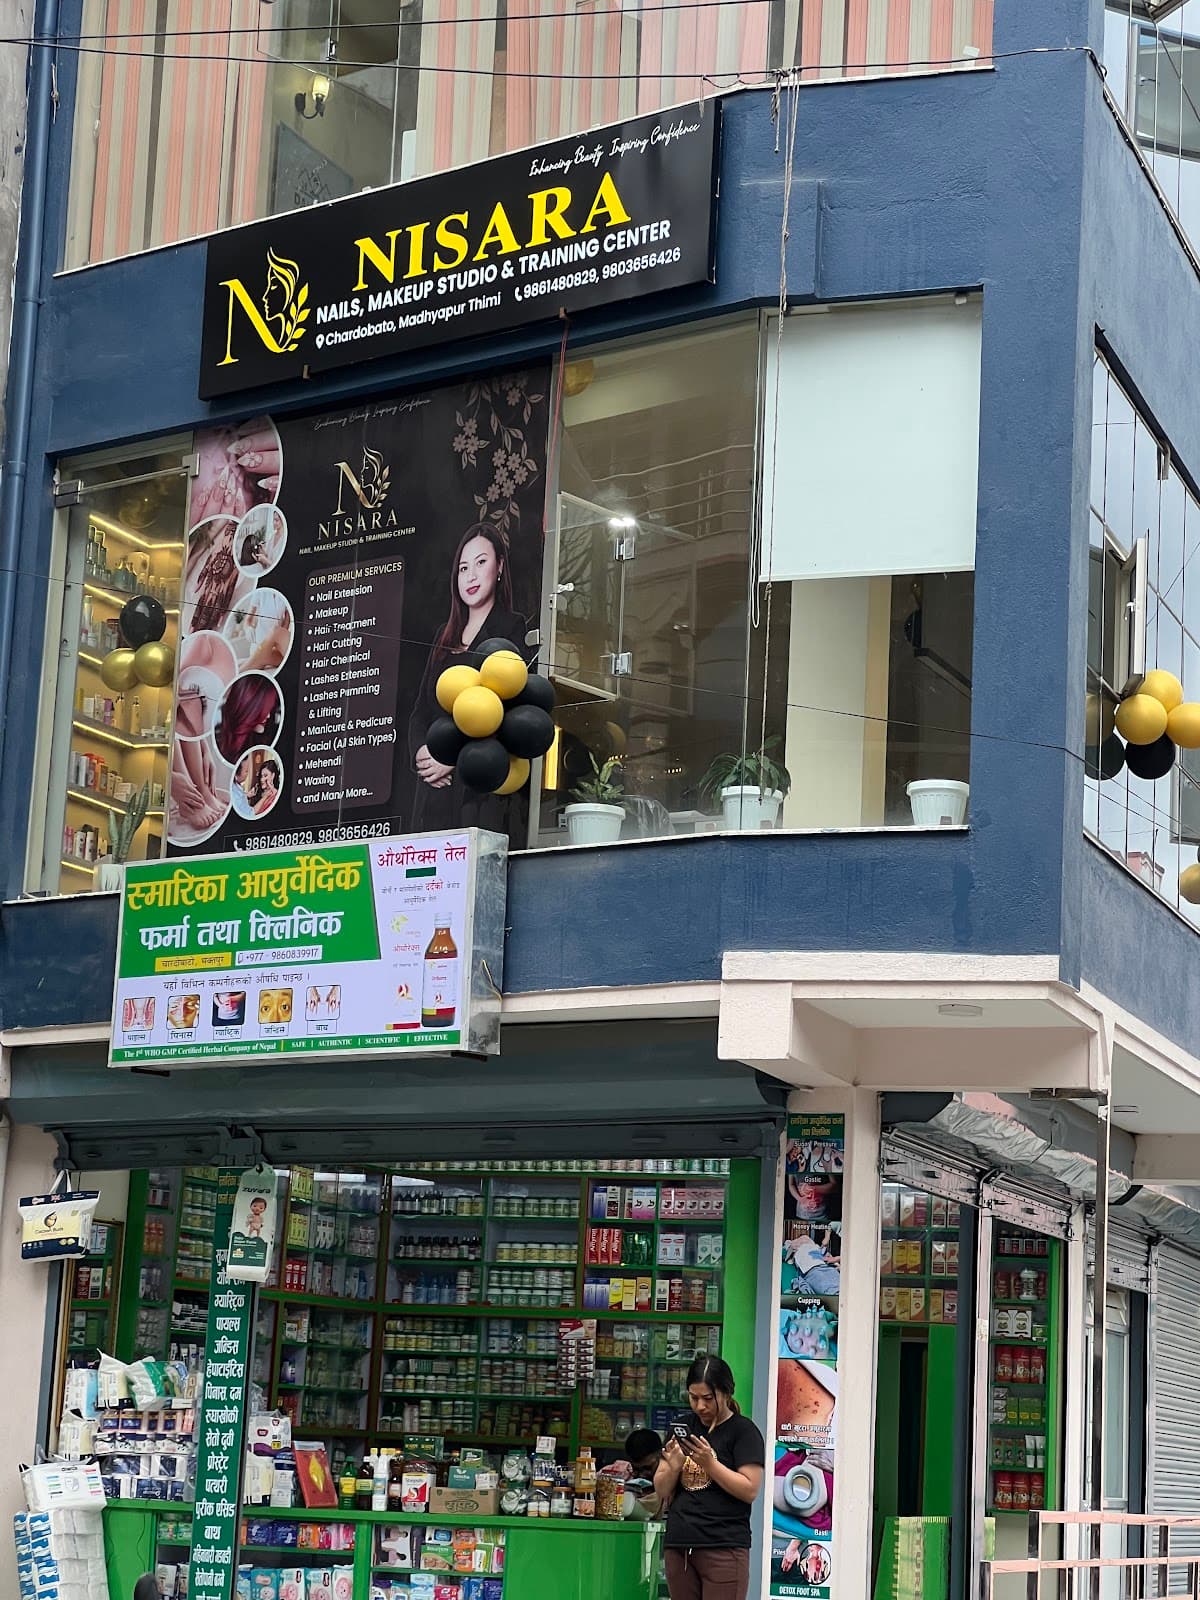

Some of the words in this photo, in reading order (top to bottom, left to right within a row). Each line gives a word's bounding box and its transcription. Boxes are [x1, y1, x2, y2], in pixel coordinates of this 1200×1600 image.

[528, 158, 573, 176] Enhancing
[574, 144, 604, 167] Beauty
[608, 137, 649, 157] Inspiring
[650, 119, 701, 146] Confidence
[351, 171, 632, 292] NISARA
[316, 297, 365, 325] NAILS,
[367, 279, 434, 312] MAKEUP
[437, 263, 498, 295] STUDIO
[500, 259, 515, 280] &
[518, 237, 600, 275] TRAINING
[603, 219, 671, 253] CENTER
[523, 268, 600, 299] 9861480829,
[602, 247, 681, 280] 9803656426
[325, 319, 397, 347] Chardobato,
[398, 301, 467, 329] Madhyapur
[468, 291, 501, 312] Thimi
[317, 508, 399, 540] NISARA
[393, 526, 416, 537] CENTER
[308, 576, 326, 587] OUR
[364, 561, 403, 577] SERVICES
[316, 590, 332, 603] Nail
[315, 605, 349, 619] Makeup
[314, 623, 331, 636] Hair
[312, 640, 330, 652] Hair
[311, 656, 329, 669] Hair
[310, 673, 340, 686] Lashes
[309, 690, 339, 703] Lashes
[308, 709, 315, 719] &
[316, 706, 342, 718] Lifting
[307, 722, 346, 736] Manicure
[347, 720, 354, 730] &
[355, 715, 393, 729] Pedicure
[306, 740, 332, 753] Facial
[348, 735, 366, 747] Skin
[367, 728, 397, 747] Types)
[304, 755, 342, 770] Mehendi
[304, 774, 336, 787] Waxing
[302, 791, 320, 804] and
[318, 822, 391, 843] 9803656426
[444, 841, 467, 862] तेल
[127, 868, 229, 910] स्मारिका
[236, 854, 364, 908] आयुर्वेदिक
[138, 914, 191, 951] फर्मा
[196, 919, 242, 946] तथा
[249, 905, 345, 943] क्लिनिक
[245, 952, 264, 962] +977
[271, 948, 319, 960] 9860839917
[124, 1049, 135, 1058] The
[144, 1048, 161, 1057] WHO
[259, 1041, 277, 1052] Nepal
[779, 1585, 796, 1595] DETOX
[796, 1586, 810, 1596] FOOT
